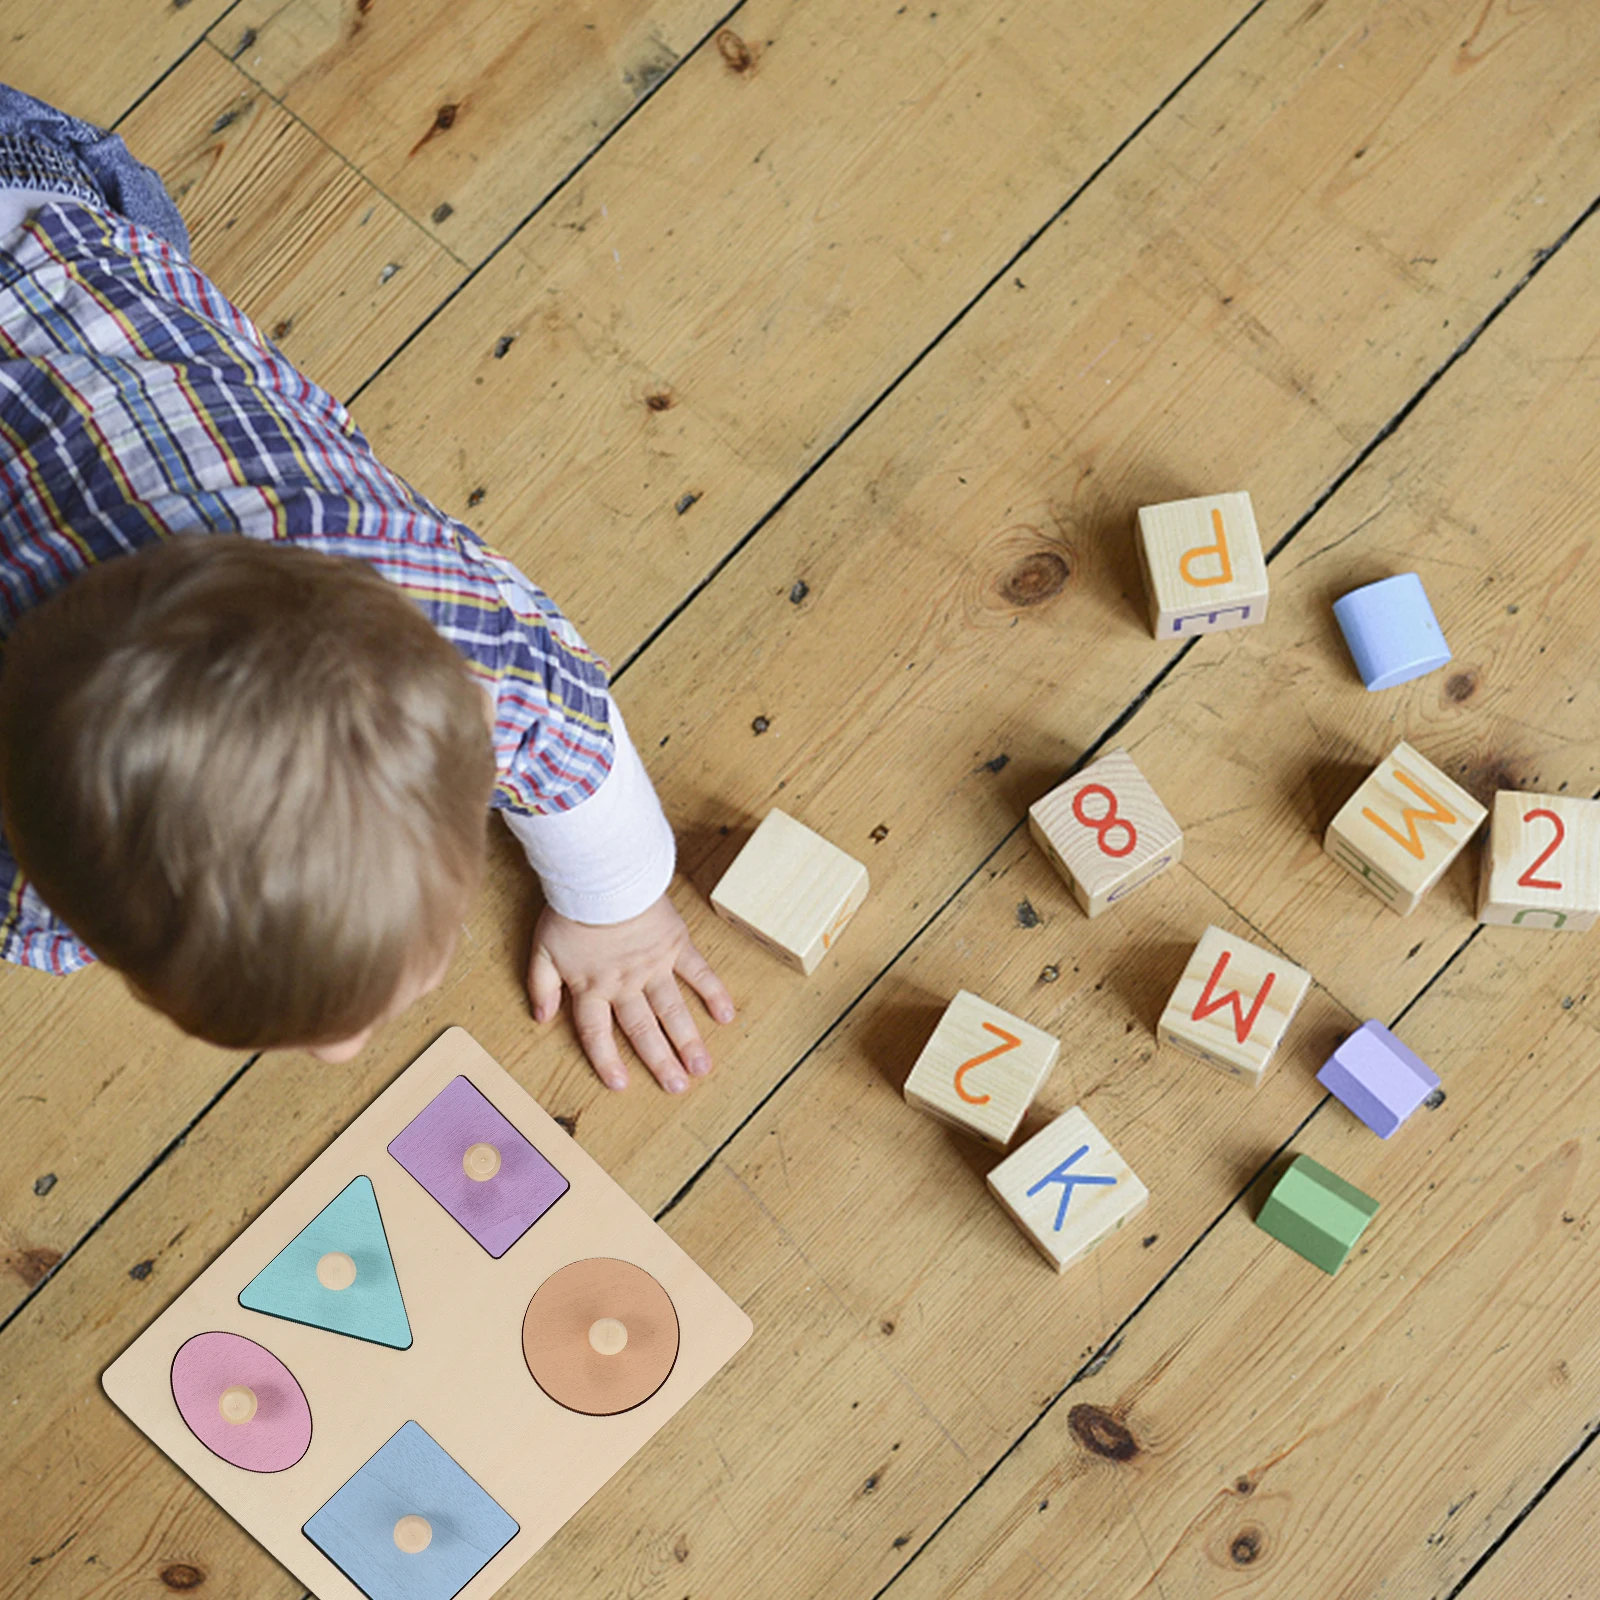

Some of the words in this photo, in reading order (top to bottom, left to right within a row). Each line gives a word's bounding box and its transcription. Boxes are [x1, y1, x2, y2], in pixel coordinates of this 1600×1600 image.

[1179, 508, 1233, 587] P
[1072, 783, 1137, 858] 8
[1517, 808, 1566, 890] 2
[954, 1021, 1022, 1105] 2
[1026, 1144, 1117, 1231] K
